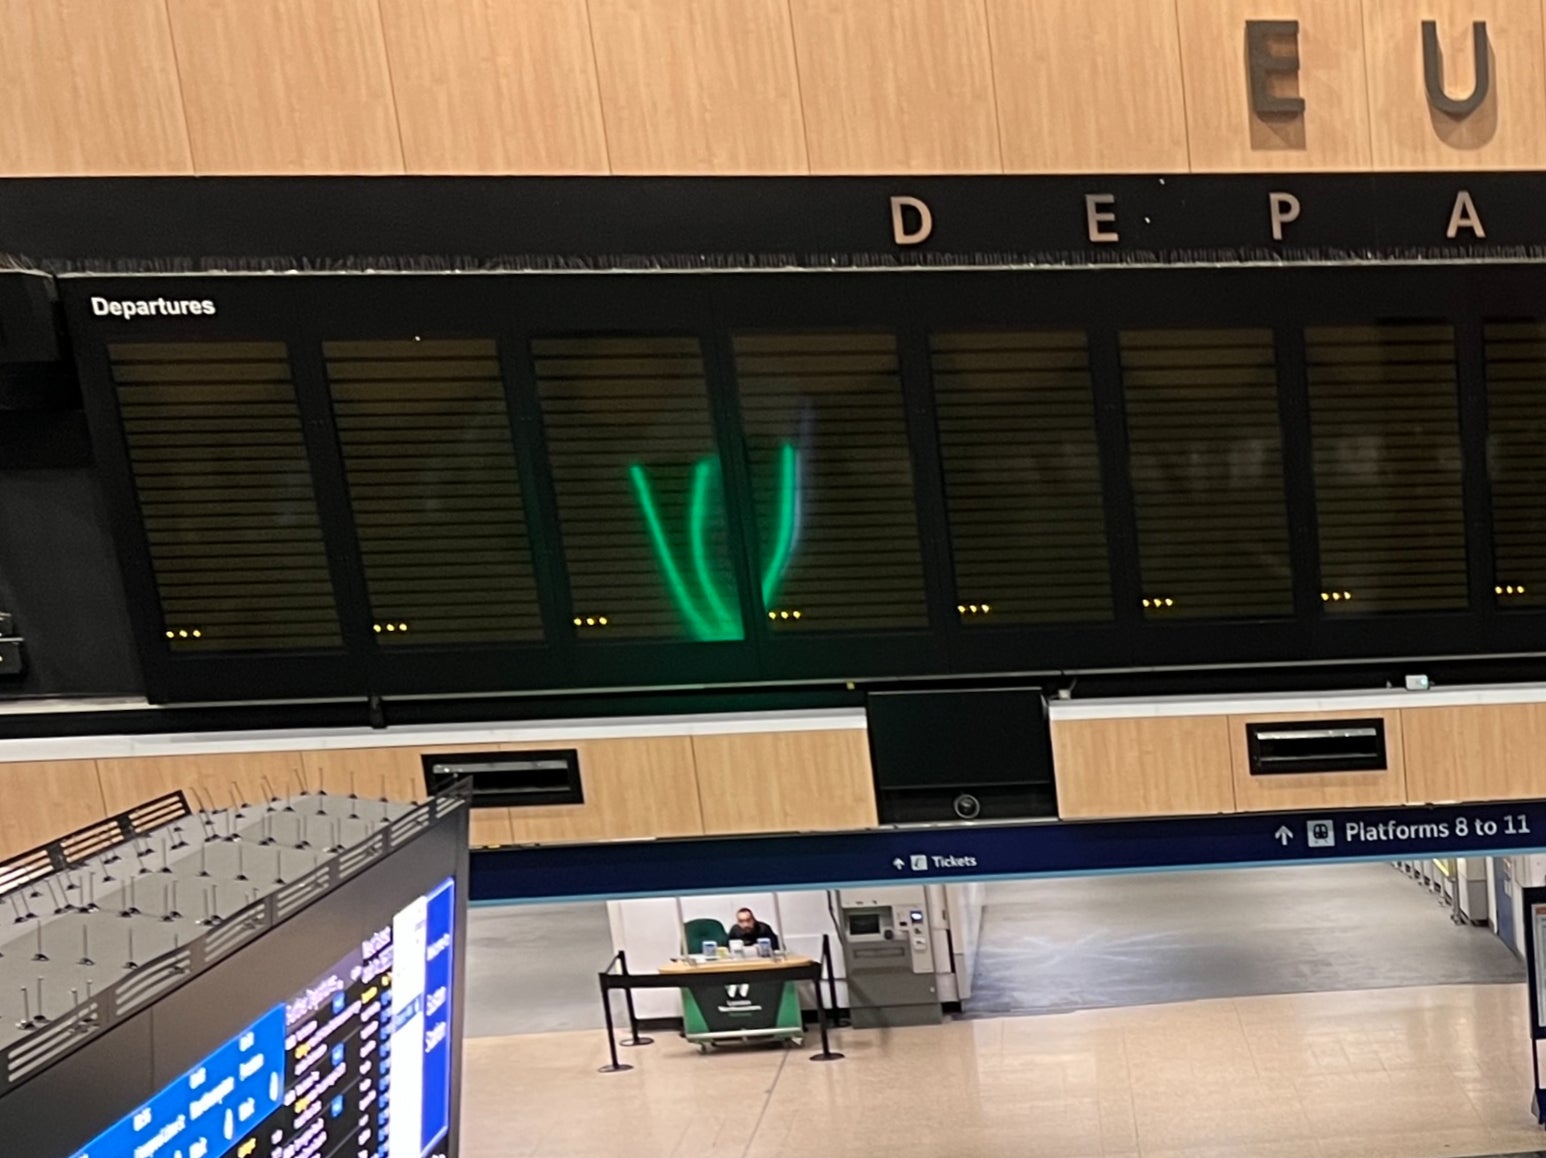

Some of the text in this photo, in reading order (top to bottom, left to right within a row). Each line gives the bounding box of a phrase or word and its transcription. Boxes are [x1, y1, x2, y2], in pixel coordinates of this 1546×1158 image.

[91, 295, 216, 319] Departures
[1345, 814, 1531, 842] Platforms 8 to 11
[931, 854, 977, 868] Tickets
